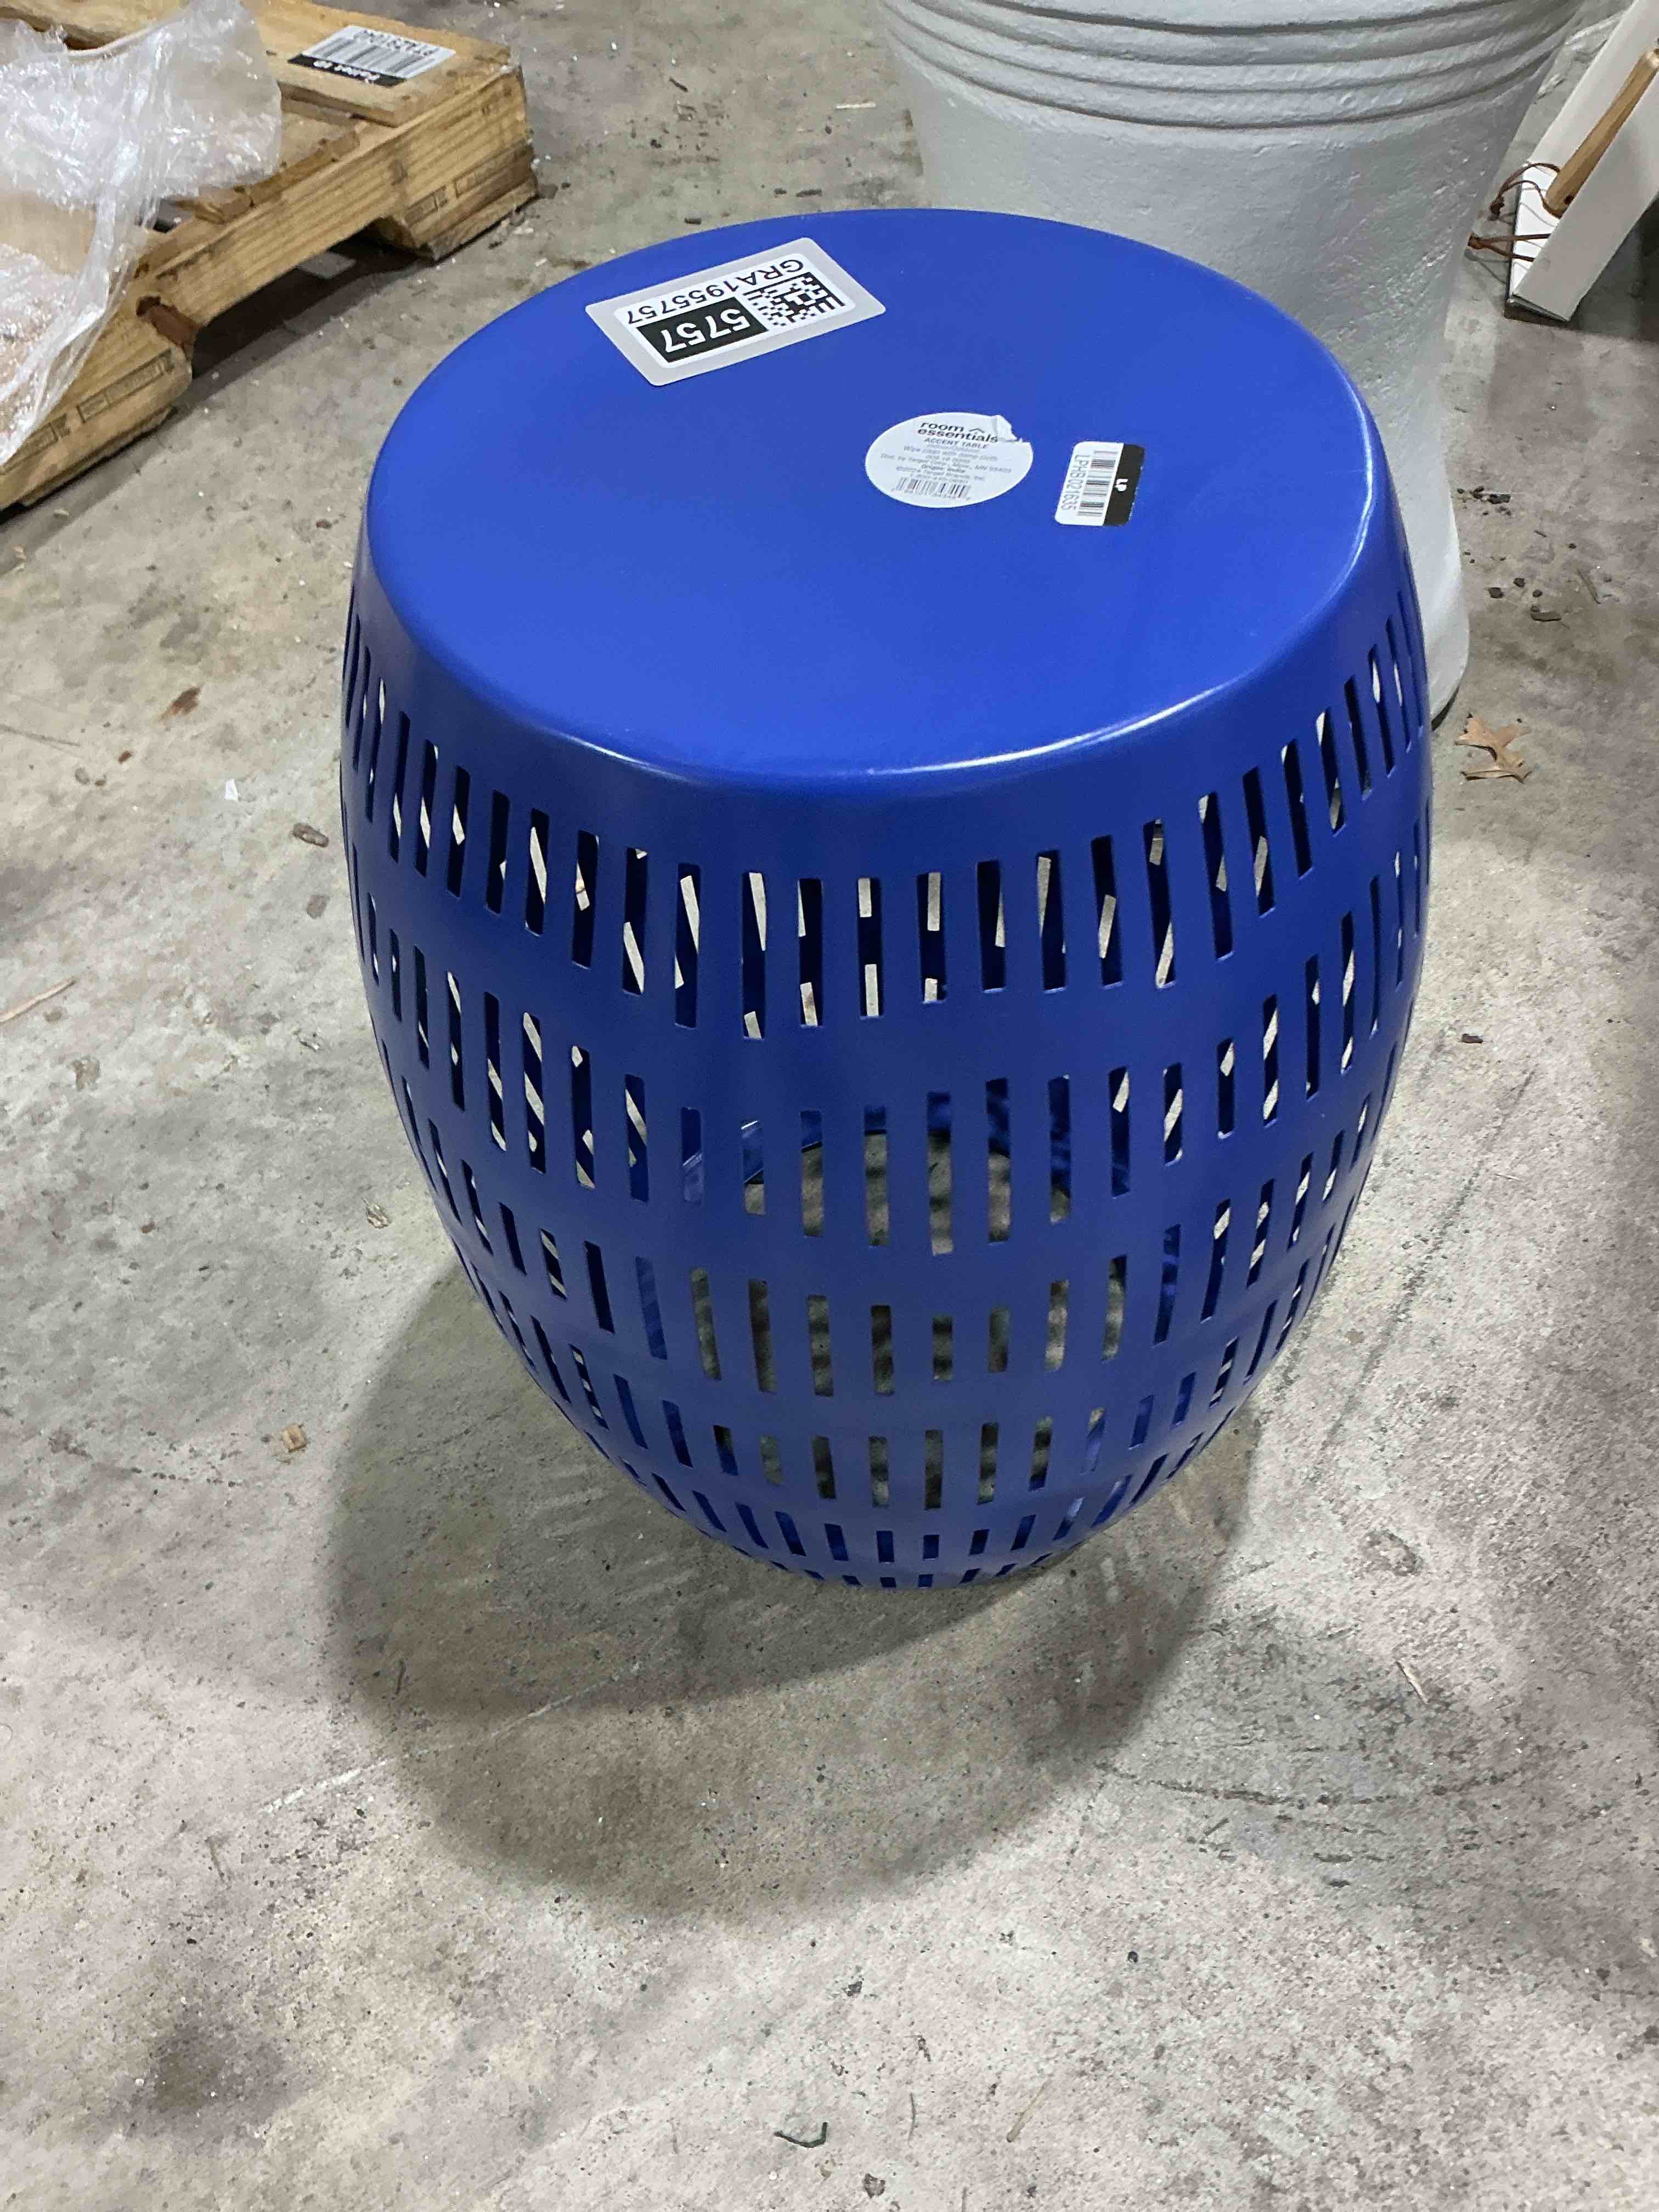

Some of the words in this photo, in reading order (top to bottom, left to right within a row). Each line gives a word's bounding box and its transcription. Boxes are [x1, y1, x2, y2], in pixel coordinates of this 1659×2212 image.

[627, 259, 804, 324] GRA1955757
[661, 308, 752, 353] 5757
[921, 422, 964, 432] room
[917, 428, 998, 443] essentials
[924, 437, 960, 446] ACCENT
[1115, 478, 1128, 492] LP
